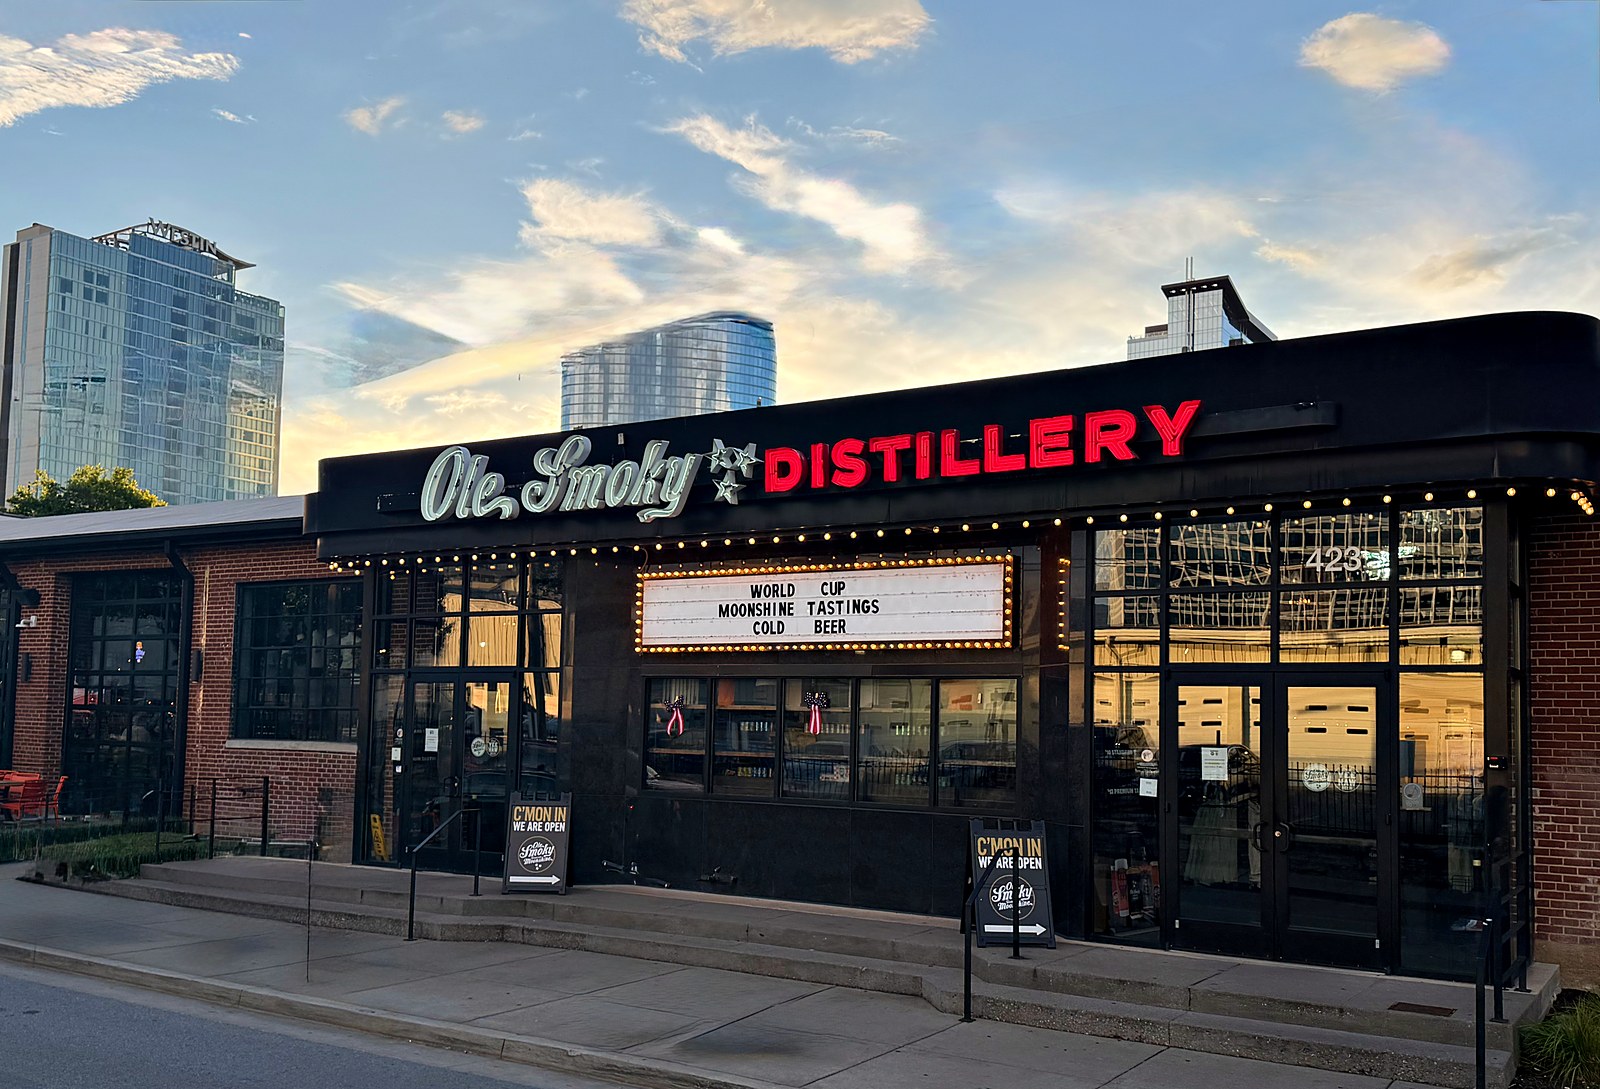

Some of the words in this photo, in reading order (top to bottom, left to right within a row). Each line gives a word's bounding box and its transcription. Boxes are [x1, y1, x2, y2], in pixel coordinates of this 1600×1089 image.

[148, 217, 217, 255] WESTIN
[421, 446, 519, 521] Ole
[521, 435, 701, 523] Smoky
[764, 400, 1200, 493] DISTILLERY
[1306, 546, 1361, 572] 423
[750, 583, 795, 599] WORLD
[821, 581, 846, 596] CUP
[718, 602, 794, 617] MOONSHINE
[807, 599, 879, 615] TASTINGS
[753, 621, 785, 635] COLD
[814, 619, 847, 634] BEER
[513, 806, 552, 822] C'MON
[554, 806, 567, 822] IN
[513, 821, 526, 832] WE
[527, 821, 543, 832] ARE
[544, 822, 566, 832] OPEN
[519, 843, 555, 859] Smoky
[1026, 838, 1042, 857] IN
[996, 856, 1014, 869] ARE
[991, 884, 1033, 903] Smky
